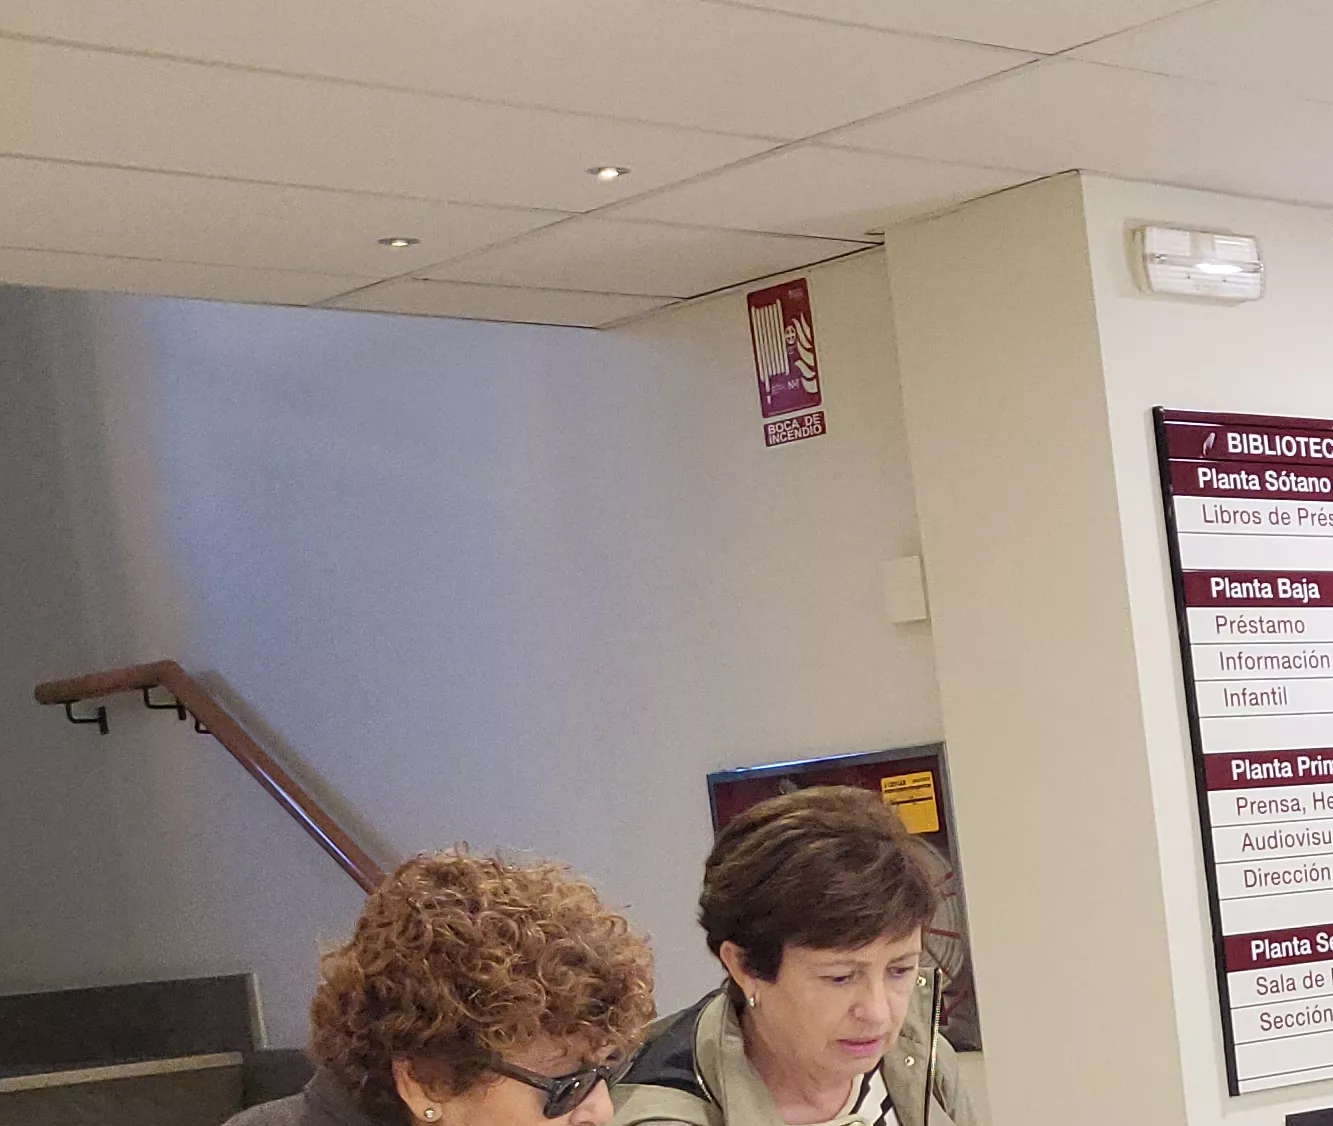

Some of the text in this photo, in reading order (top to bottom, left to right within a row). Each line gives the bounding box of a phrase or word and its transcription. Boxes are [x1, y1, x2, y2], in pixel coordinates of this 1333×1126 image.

[768, 414, 821, 434] BOCA DE
[769, 425, 822, 445] INCENDIO
[1198, 467, 1331, 493] Planta Sótano
[1202, 504, 1262, 525] Libros
[1268, 506, 1291, 525] de
[1211, 577, 1320, 603] Planta Baja
[1216, 615, 1305, 635] Préstamo
[1220, 651, 1331, 671] Información
[1224, 686, 1288, 708] Infantil
[1231, 758, 1293, 780] Planta
[1236, 795, 1307, 817] Prensa,
[1251, 936, 1312, 961] Planta
[1256, 974, 1296, 996] Sala
[1303, 971, 1325, 990] de
[1260, 1004, 1333, 1033] Sección
